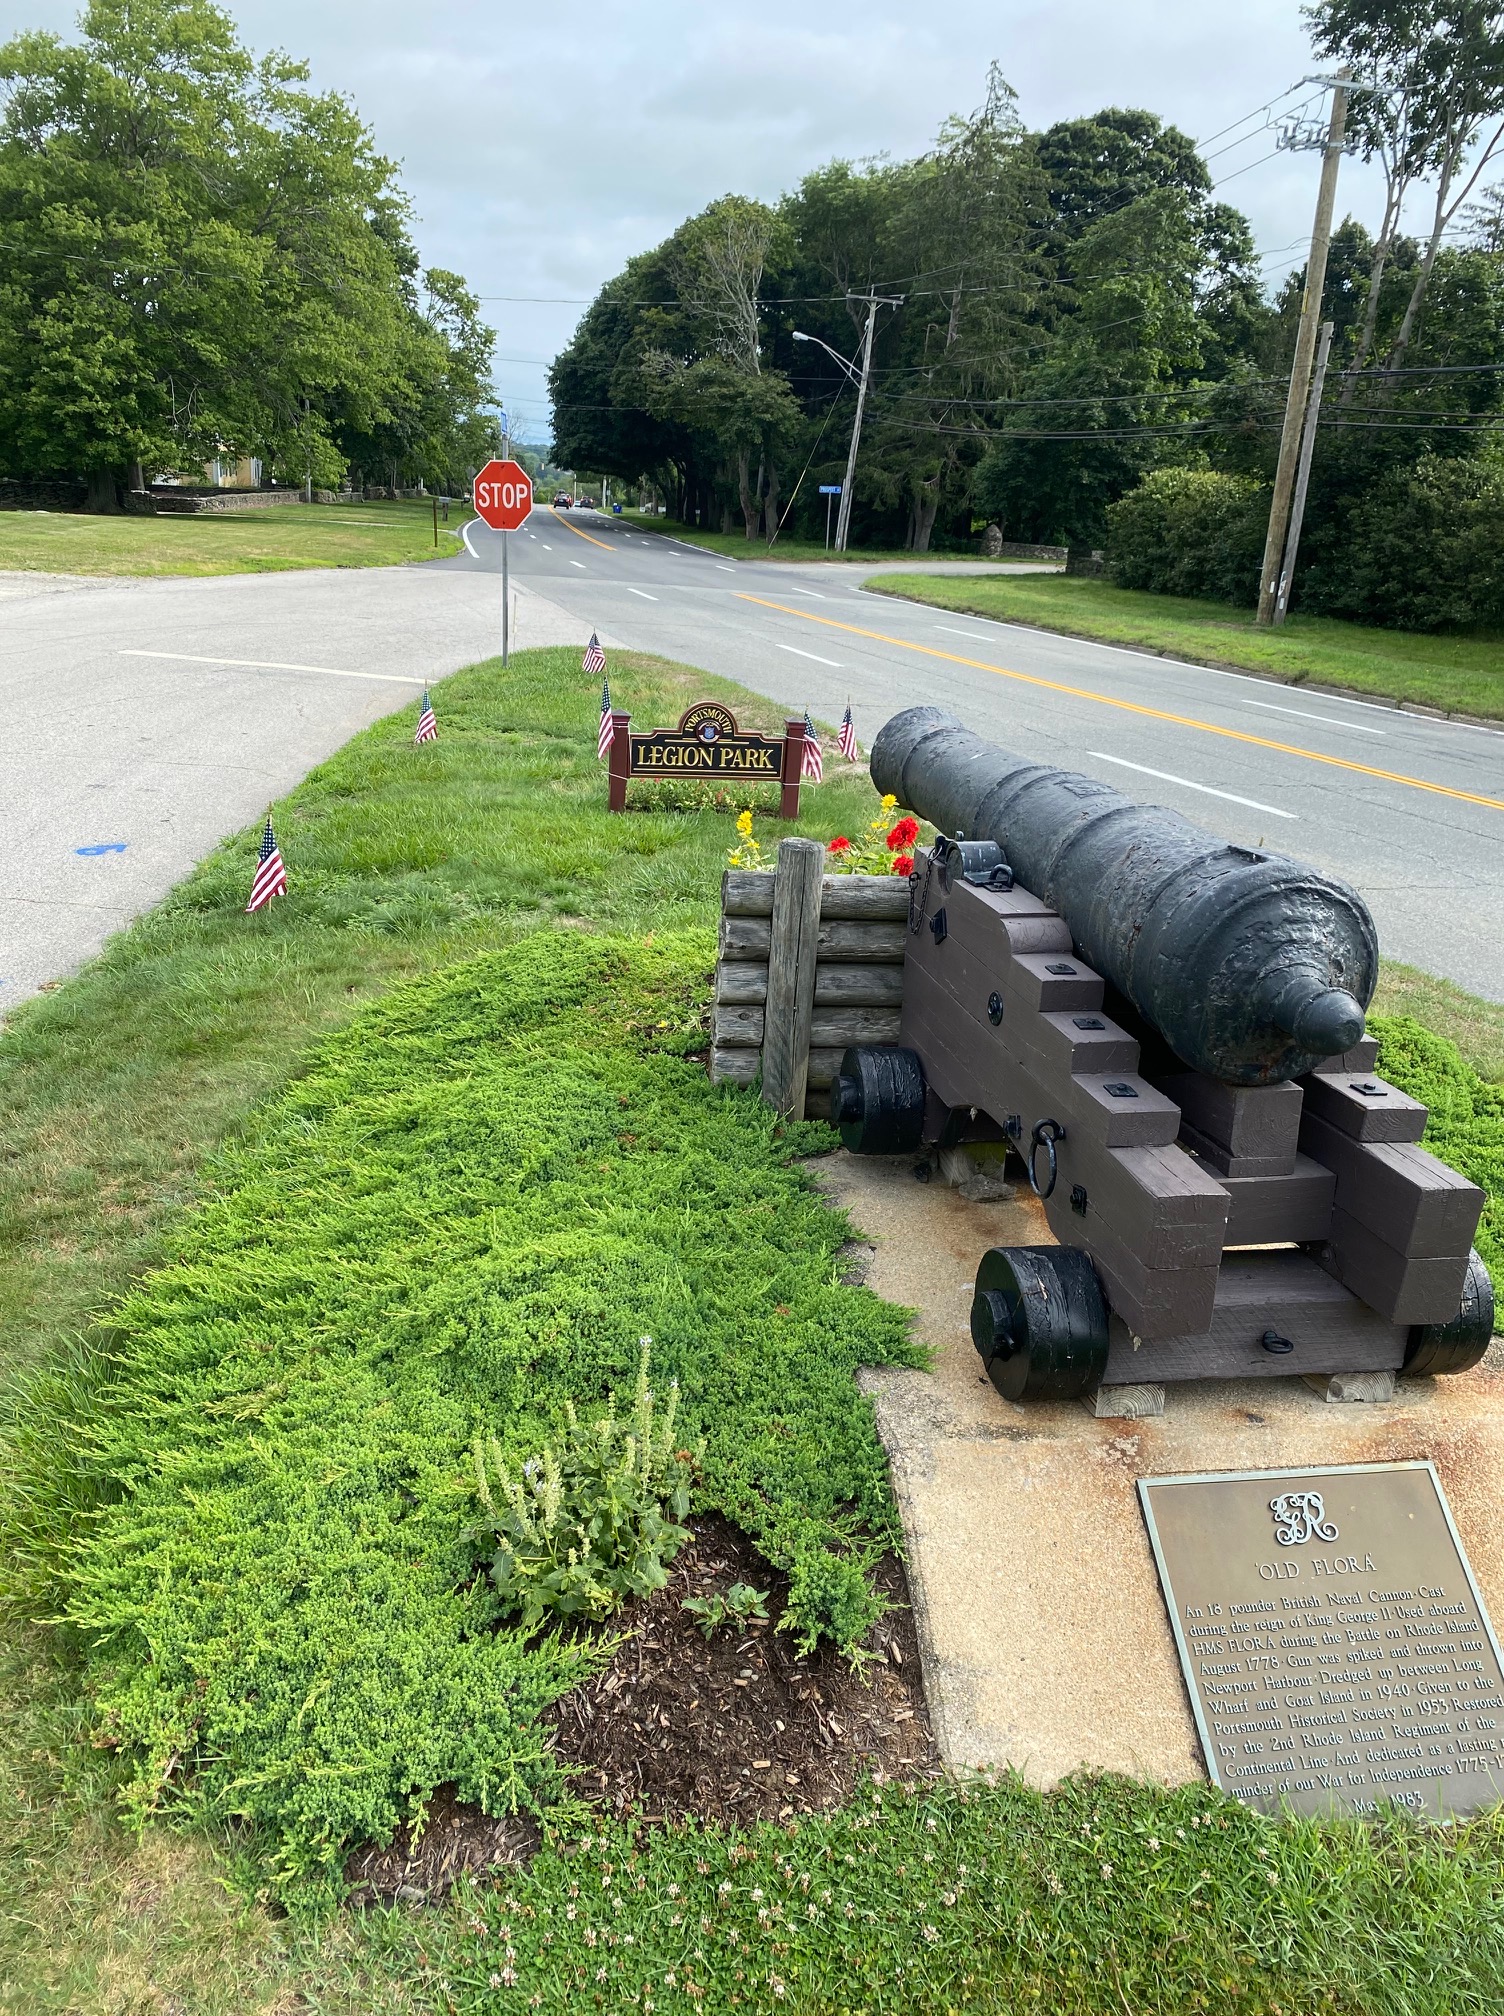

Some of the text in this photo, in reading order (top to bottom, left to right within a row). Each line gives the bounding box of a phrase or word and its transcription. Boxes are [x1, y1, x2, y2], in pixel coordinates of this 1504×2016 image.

[478, 482, 528, 509] STOP
[684, 708, 732, 733] PORTSMOUTH
[637, 745, 774, 769] LEGION PARK
[1185, 1604, 1204, 1618] An
[1207, 1603, 1223, 1616] 18
[1229, 1600, 1277, 1616] pounder
[1281, 1595, 1322, 1610] British
[1326, 1591, 1363, 1606] Naval
[1189, 1624, 1228, 1637] during
[1230, 1620, 1250, 1634] the
[1254, 1618, 1286, 1632] reign
[1290, 1614, 1301, 1628] of
[1304, 1613, 1334, 1627] King
[1337, 1610, 1378, 1624] George
[1429, 1601, 1467, 1616] aboard
[1192, 1619, 1480, 1656] HMS FLORA during the Battle on Rhode Island
[1200, 1639, 1484, 1677] August 1778 Gun was spiked and thrown into
[1202, 1680, 1258, 1695] Newport
[1378, 1670, 1393, 1681] up
[1397, 1663, 1450, 1678] between
[1451, 1658, 1485, 1672] Long
[1208, 1698, 1249, 1715] Wharf
[1256, 1696, 1279, 1711] and
[1285, 1693, 1315, 1708] Goat
[1319, 1689, 1355, 1704] Island
[1359, 1688, 1373, 1700] in
[1417, 1681, 1452, 1695] Given
[1456, 1679, 1470, 1691] to
[1474, 1676, 1495, 1689] the
[1213, 1715, 1284, 1736] Portsmouth
[1289, 1709, 1348, 1728] Historical
[1352, 1706, 1397, 1722] Society
[1400, 1704, 1414, 1717] in
[1451, 1694, 1504, 1711] Restored
[1218, 1715, 1497, 1758] by the 2nd Rhode Island Regiment of the
[1225, 1756, 1296, 1778] Continental
[1299, 1755, 1329, 1770] Line
[1334, 1750, 1361, 1766] And
[1366, 1743, 1424, 1762] dedicated
[1429, 1744, 1442, 1755] as
[1447, 1744, 1455, 1754] a
[1457, 1738, 1498, 1752] lasting
[1231, 1782, 1273, 1798] minder
[1278, 1777, 1290, 1793] of
[1295, 1779, 1316, 1791] our
[1316, 1773, 1344, 1788] War
[1347, 1770, 1366, 1786] for
[1368, 1763, 1453, 1783] Independence
[1390, 1791, 1424, 1809] 1983
